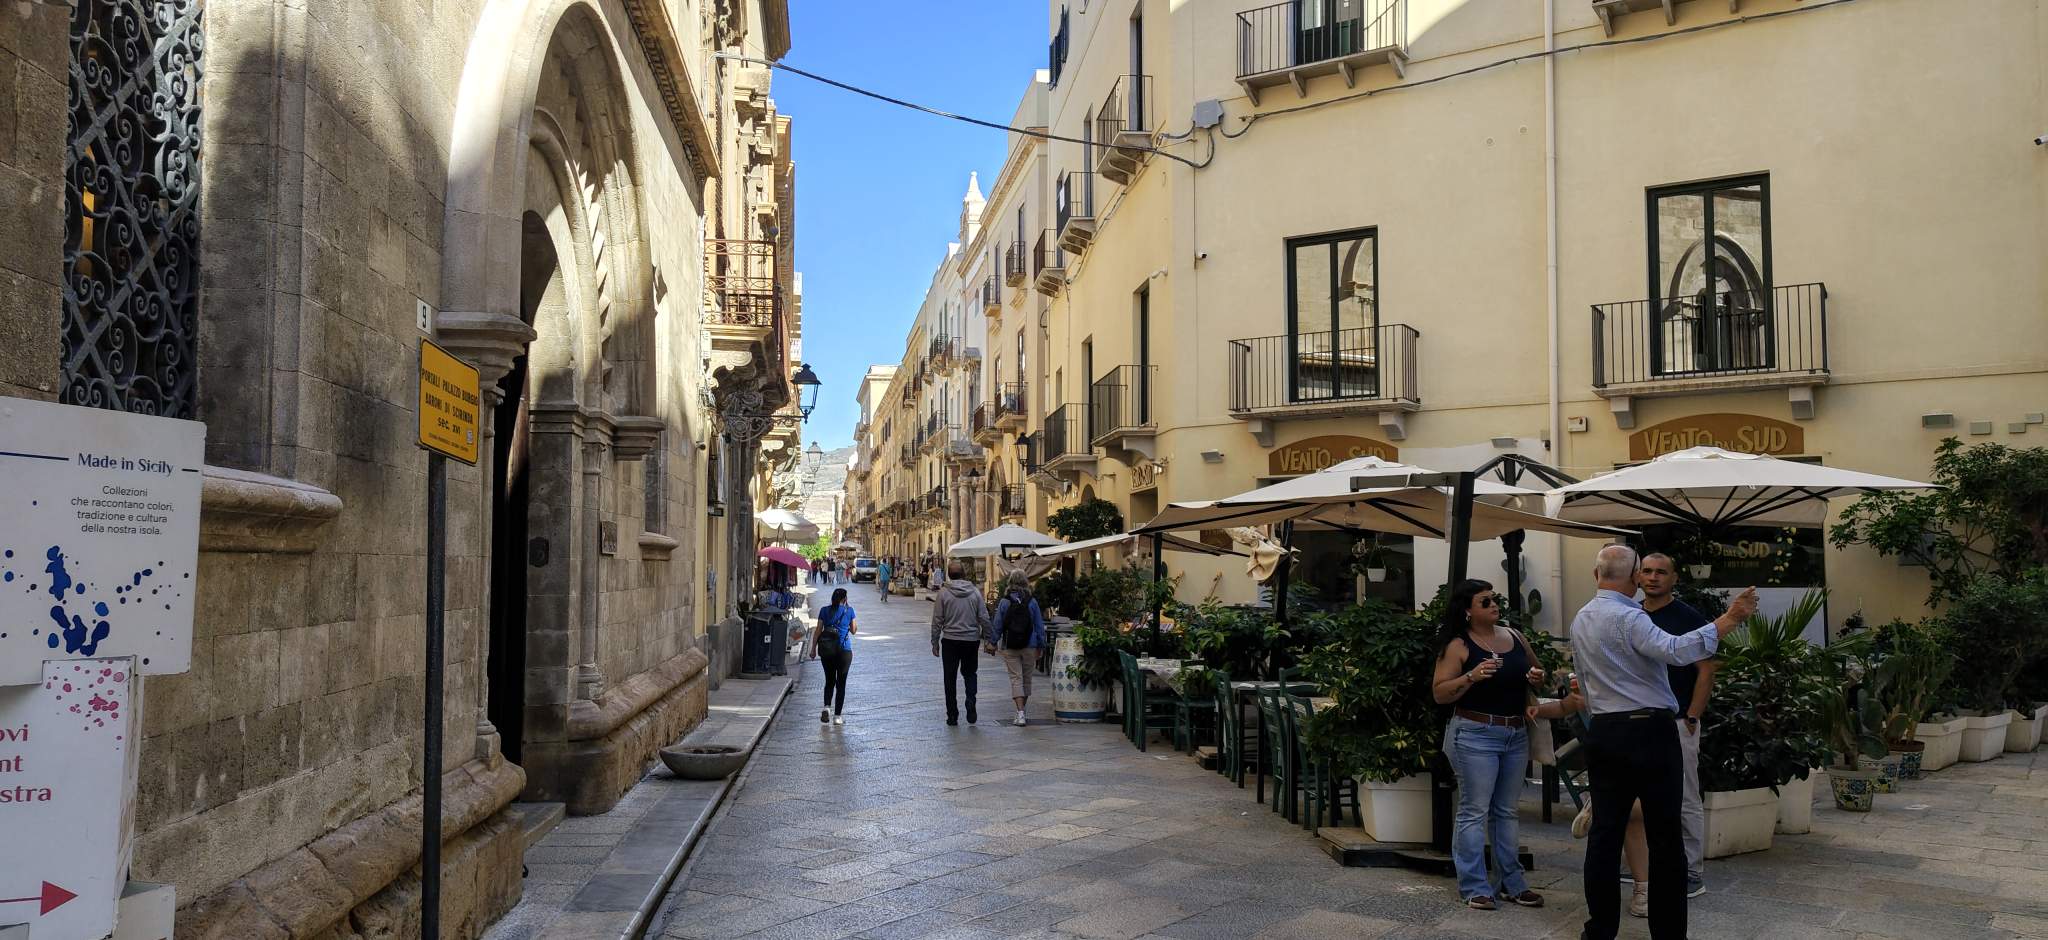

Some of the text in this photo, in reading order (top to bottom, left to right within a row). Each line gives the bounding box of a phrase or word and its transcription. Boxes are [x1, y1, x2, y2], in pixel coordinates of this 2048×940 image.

[422, 306, 427, 328] 9
[1644, 427, 1713, 456] VENTO
[1737, 425, 1788, 453] SUD
[78, 453, 174, 477] Made in Sicily
[1279, 447, 1330, 471] VENTO
[102, 485, 148, 497] Collezioni
[71, 497, 174, 512] che raccontano colori,
[77, 510, 126, 521] tradizione
[136, 512, 168, 523] cultura
[81, 523, 162, 535] della nostra isola.
[1738, 540, 1770, 559] SUD
